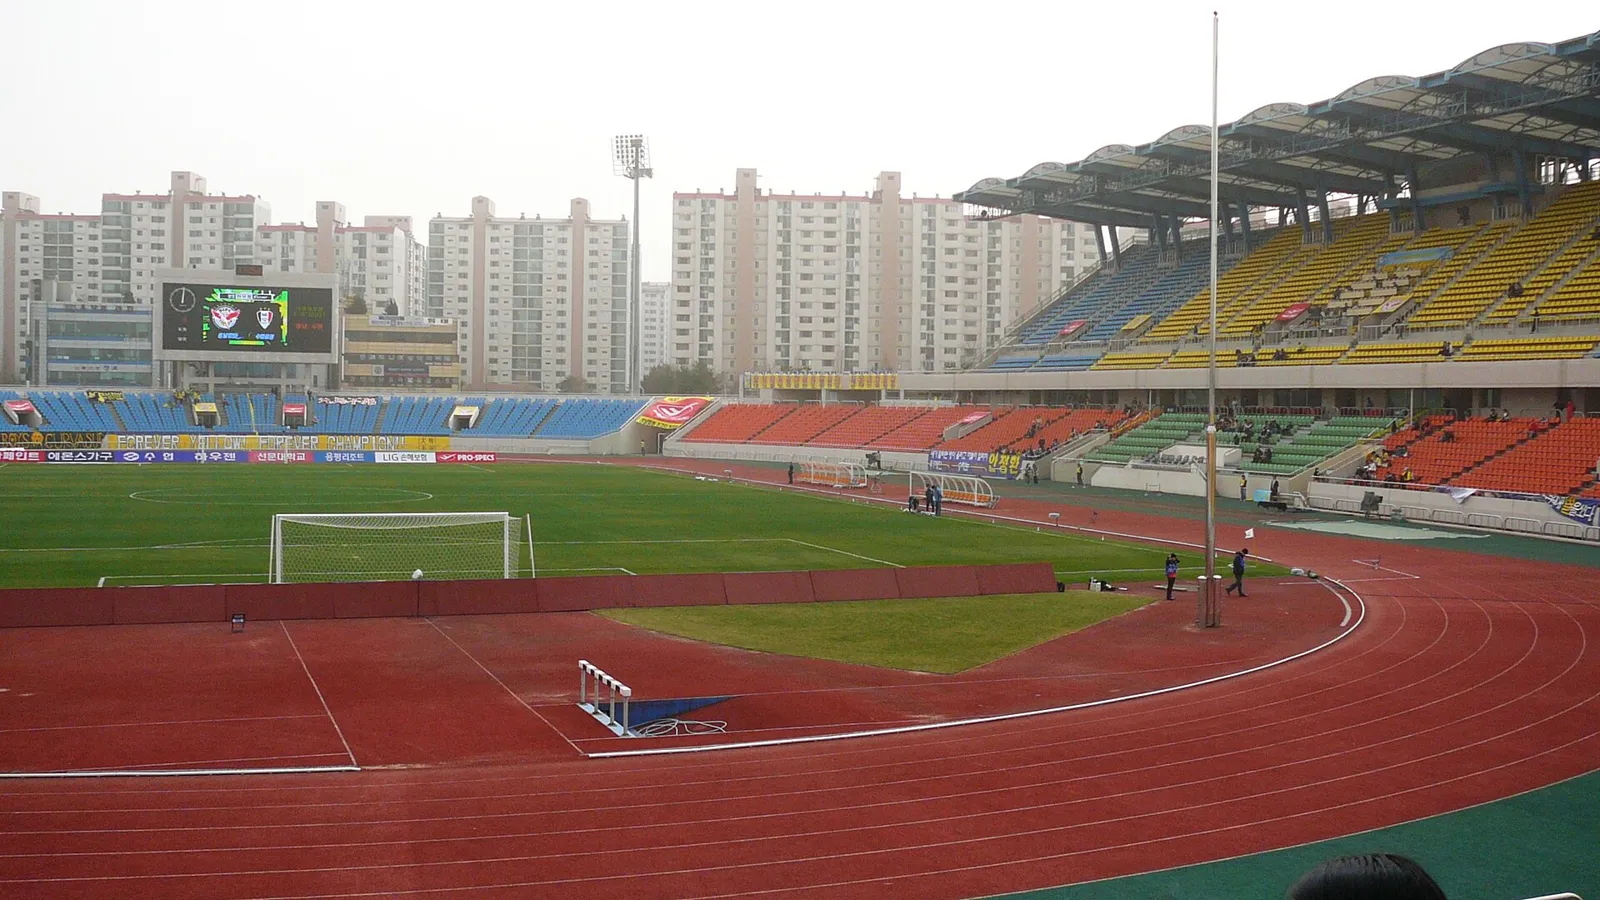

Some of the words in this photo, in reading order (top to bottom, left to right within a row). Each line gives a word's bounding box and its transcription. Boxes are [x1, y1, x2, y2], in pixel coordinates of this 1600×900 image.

[117, 434, 179, 450] FOREVER
[259, 435, 319, 450] FOREVER
[382, 453, 399, 462] LIG
[457, 453, 495, 462] PRO-SPECS
